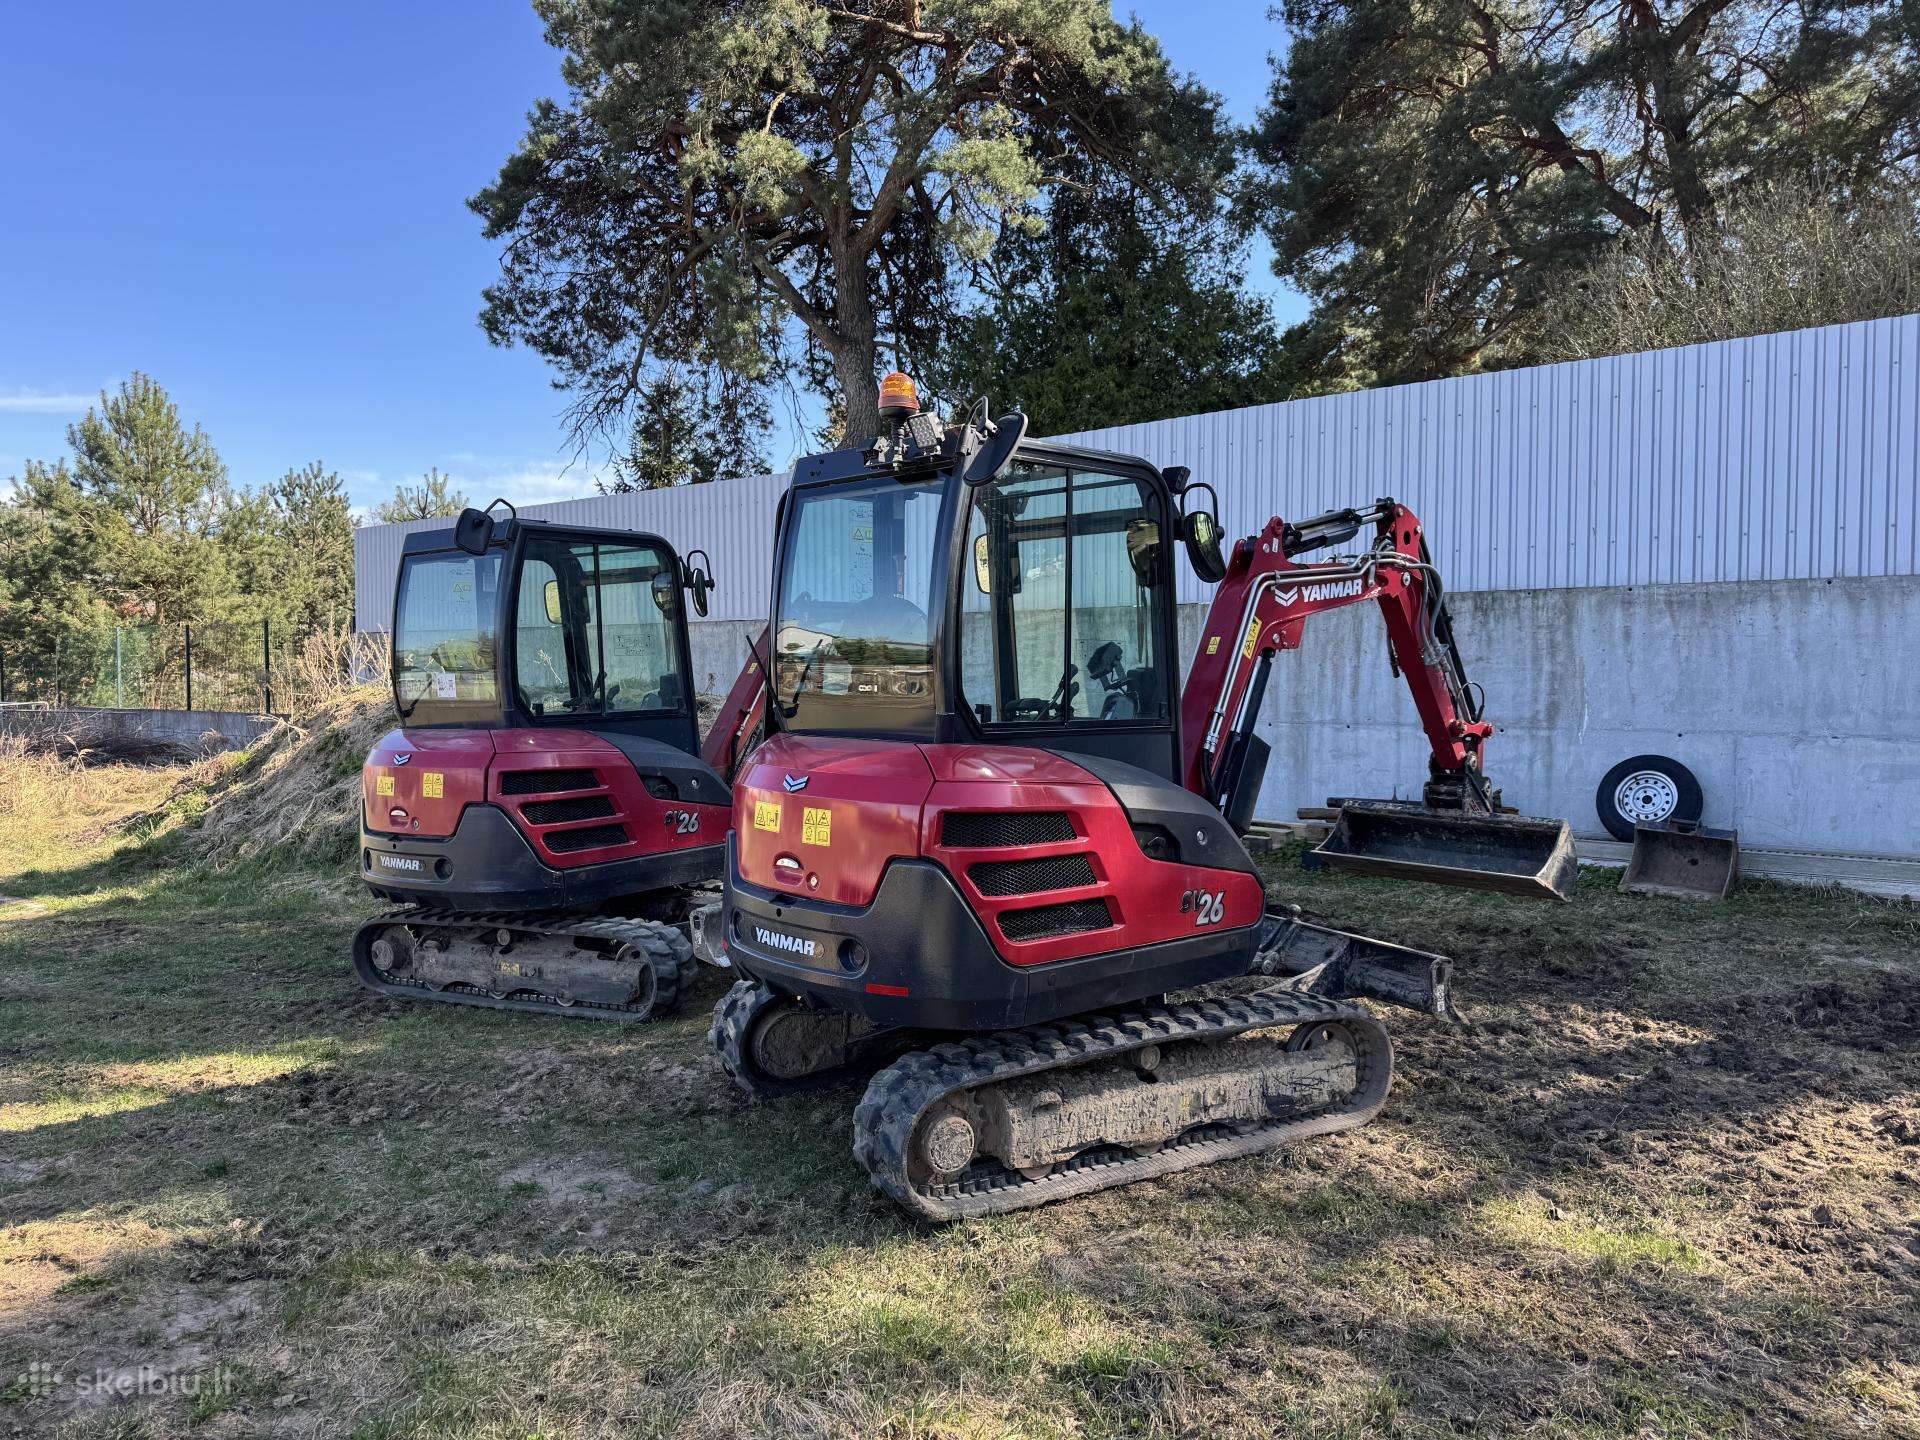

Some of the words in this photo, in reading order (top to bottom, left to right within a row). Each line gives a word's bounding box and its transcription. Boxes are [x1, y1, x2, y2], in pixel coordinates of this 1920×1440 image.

[1301, 578, 1362, 603] YANMAR
[380, 855, 420, 871] YANMAR
[755, 926, 815, 956] YANMAR
